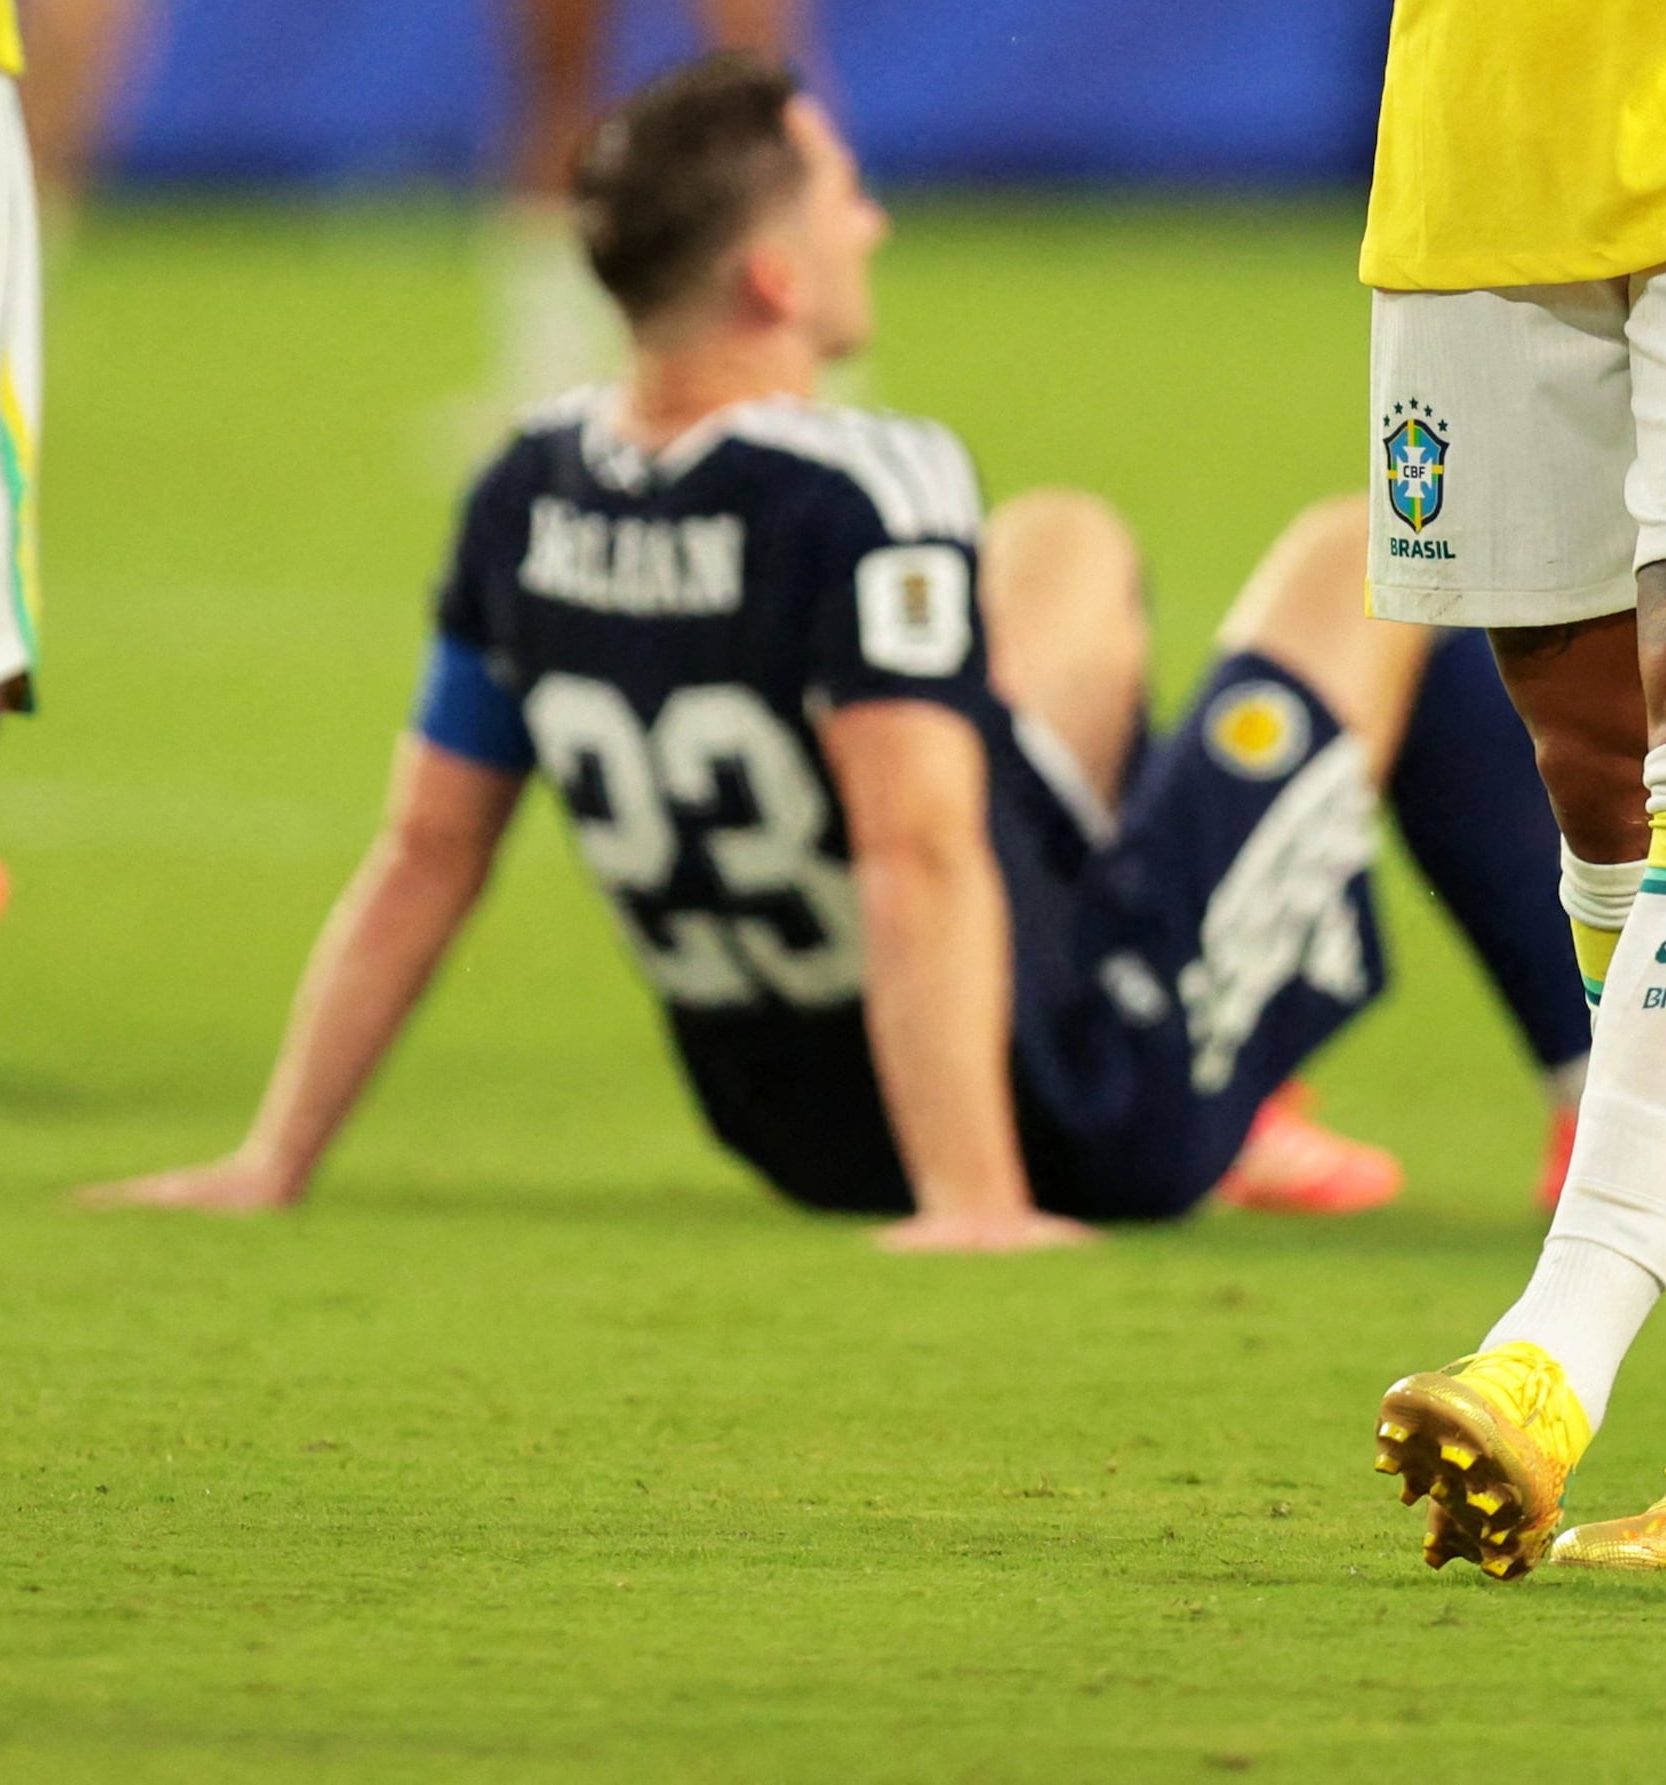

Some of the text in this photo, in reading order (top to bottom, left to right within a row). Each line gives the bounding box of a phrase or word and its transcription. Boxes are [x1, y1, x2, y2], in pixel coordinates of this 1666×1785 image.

[1403, 465, 1426, 478] CBF
[1390, 537, 1456, 560] BRASIL
[521, 669, 865, 1009] 23
